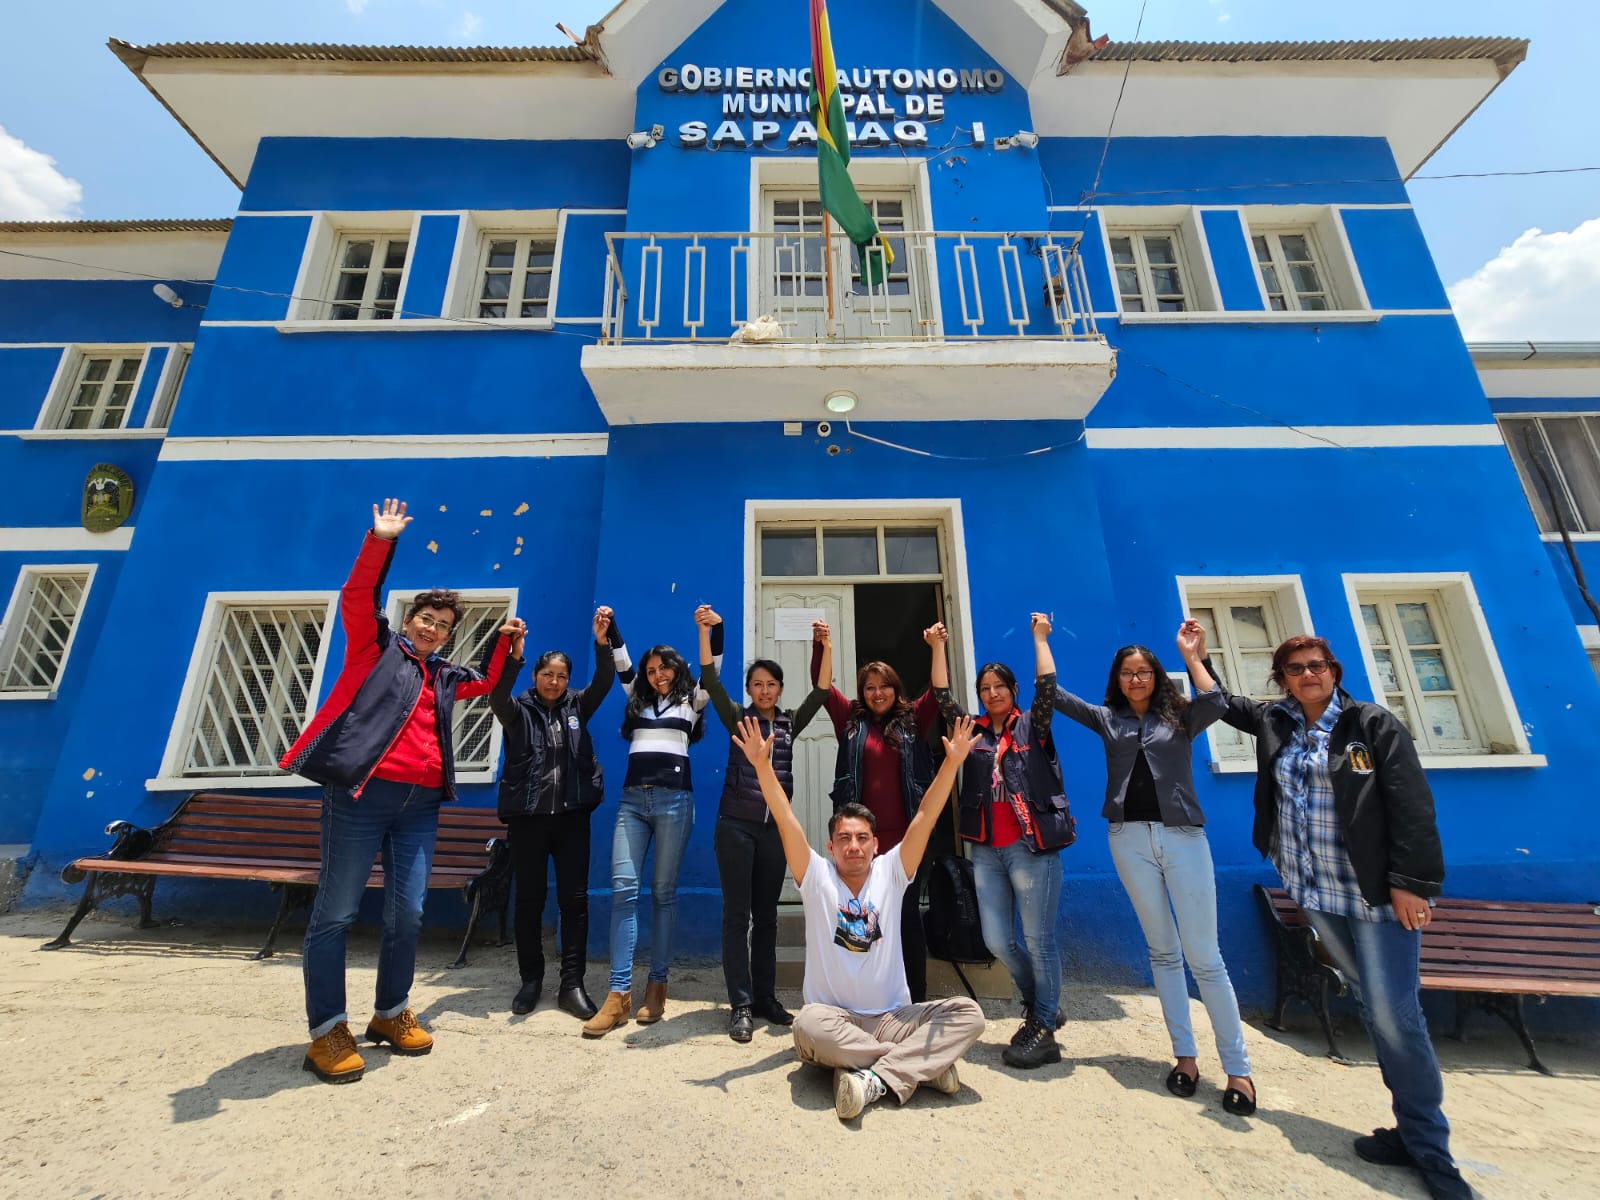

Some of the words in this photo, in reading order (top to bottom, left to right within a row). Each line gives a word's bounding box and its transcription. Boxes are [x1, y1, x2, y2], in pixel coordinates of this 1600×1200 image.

[836, 67, 1005, 92] AUTONOMO
[722, 92, 896, 116] MUNIPAL
[905, 94, 945, 117] DE
